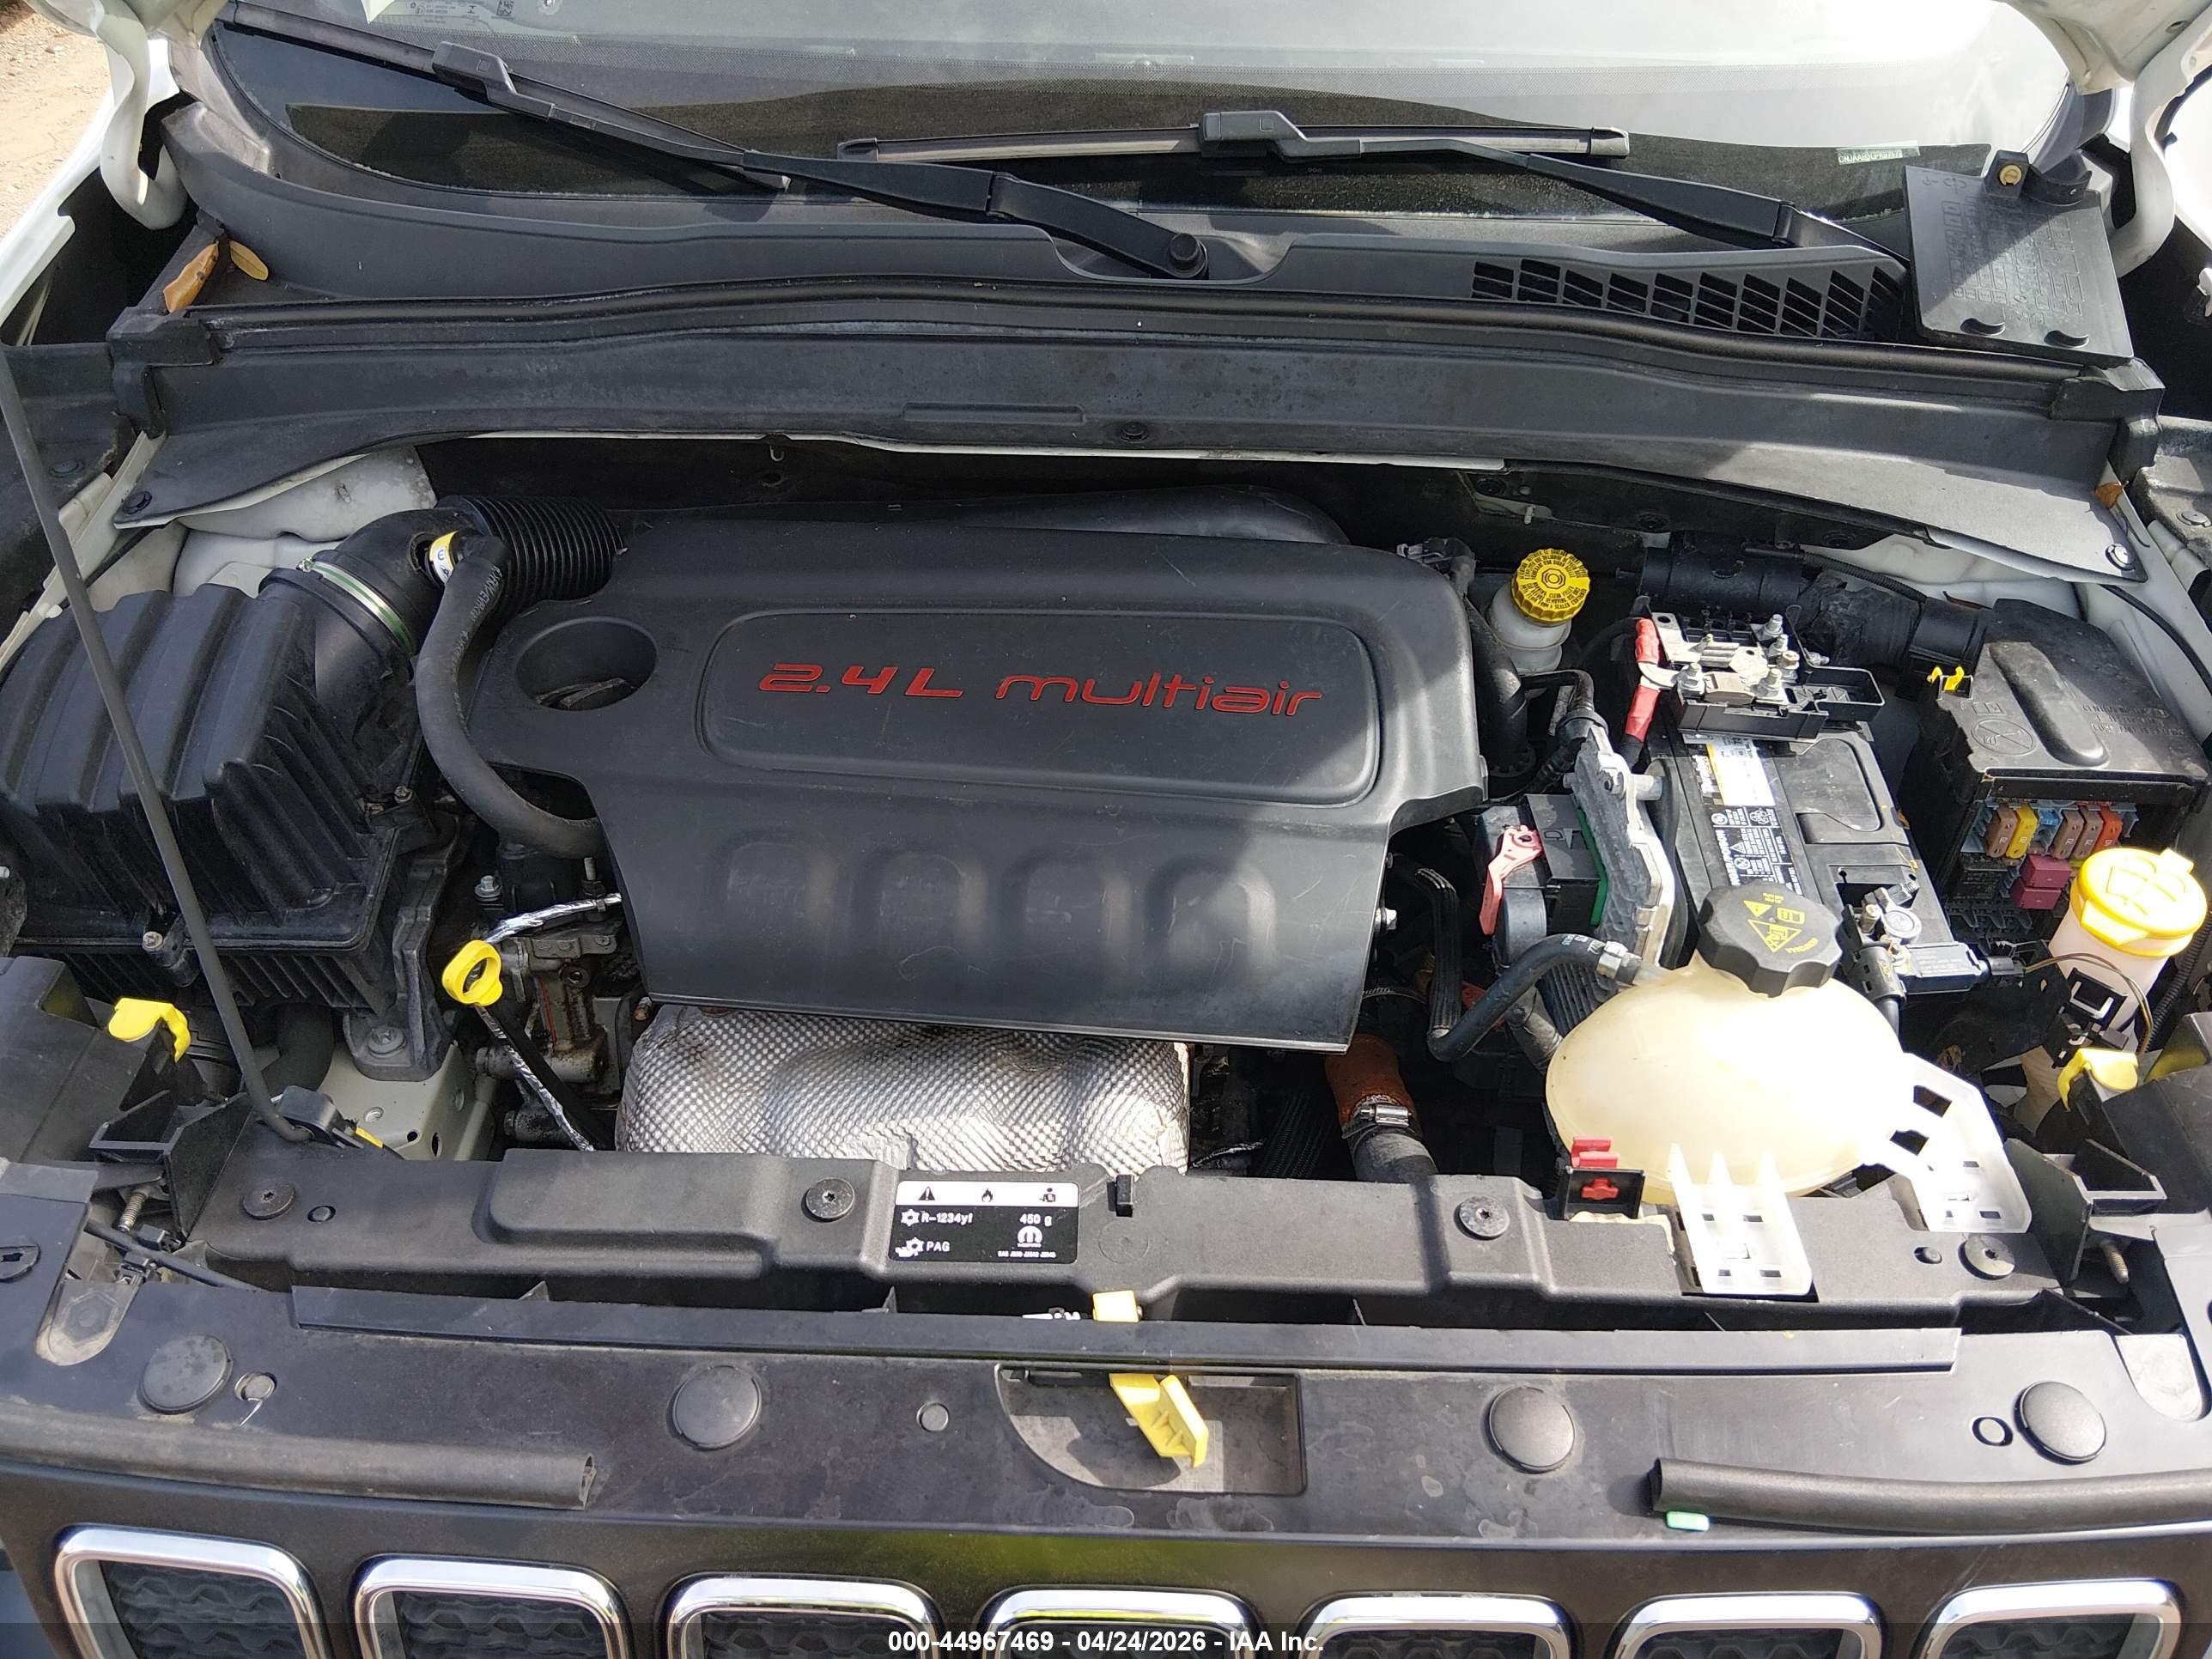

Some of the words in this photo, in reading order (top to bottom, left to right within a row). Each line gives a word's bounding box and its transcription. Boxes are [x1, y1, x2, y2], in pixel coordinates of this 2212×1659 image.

[995, 672, 1322, 715] multiair
[921, 1212, 974, 1226] R-1234yf
[1019, 1213, 1042, 1224] 450
[1044, 1215, 1053, 1226] g
[926, 1241, 951, 1252] PAG
